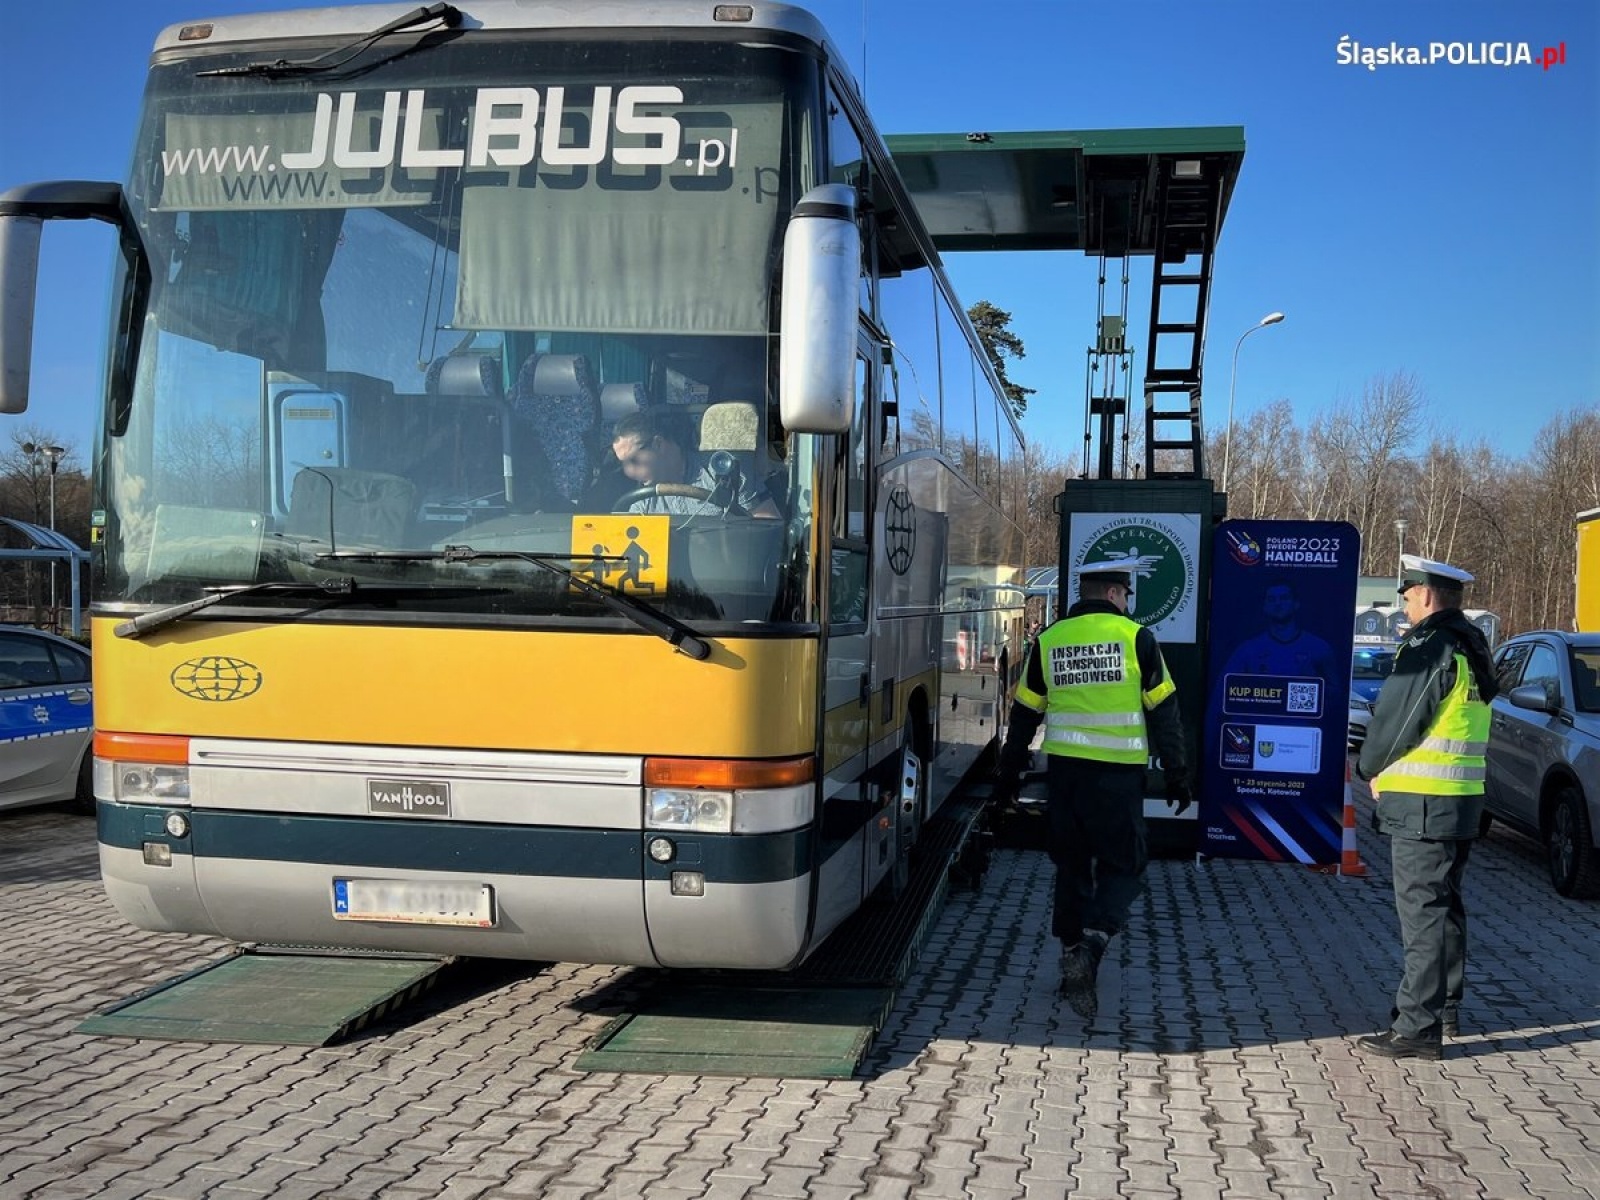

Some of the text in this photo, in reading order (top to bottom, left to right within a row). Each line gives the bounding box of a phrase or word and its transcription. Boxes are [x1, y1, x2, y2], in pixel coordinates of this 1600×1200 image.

[1096, 529, 1171, 552] INSPEKCJA
[1299, 538, 1340, 551] 2023
[1083, 516, 1137, 549] INSPEKTORAT
[1139, 517, 1189, 555] TRANSPORTU
[1178, 554, 1194, 613] DROGOWEGO
[1265, 551, 1339, 563] HANDBALL
[1052, 643, 1120, 660] INSPEKCJA
[1053, 656, 1121, 672] TRANSPORTU
[1054, 670, 1122, 686] DROGOWEGO
[1229, 686, 1283, 698] KUP BILET
